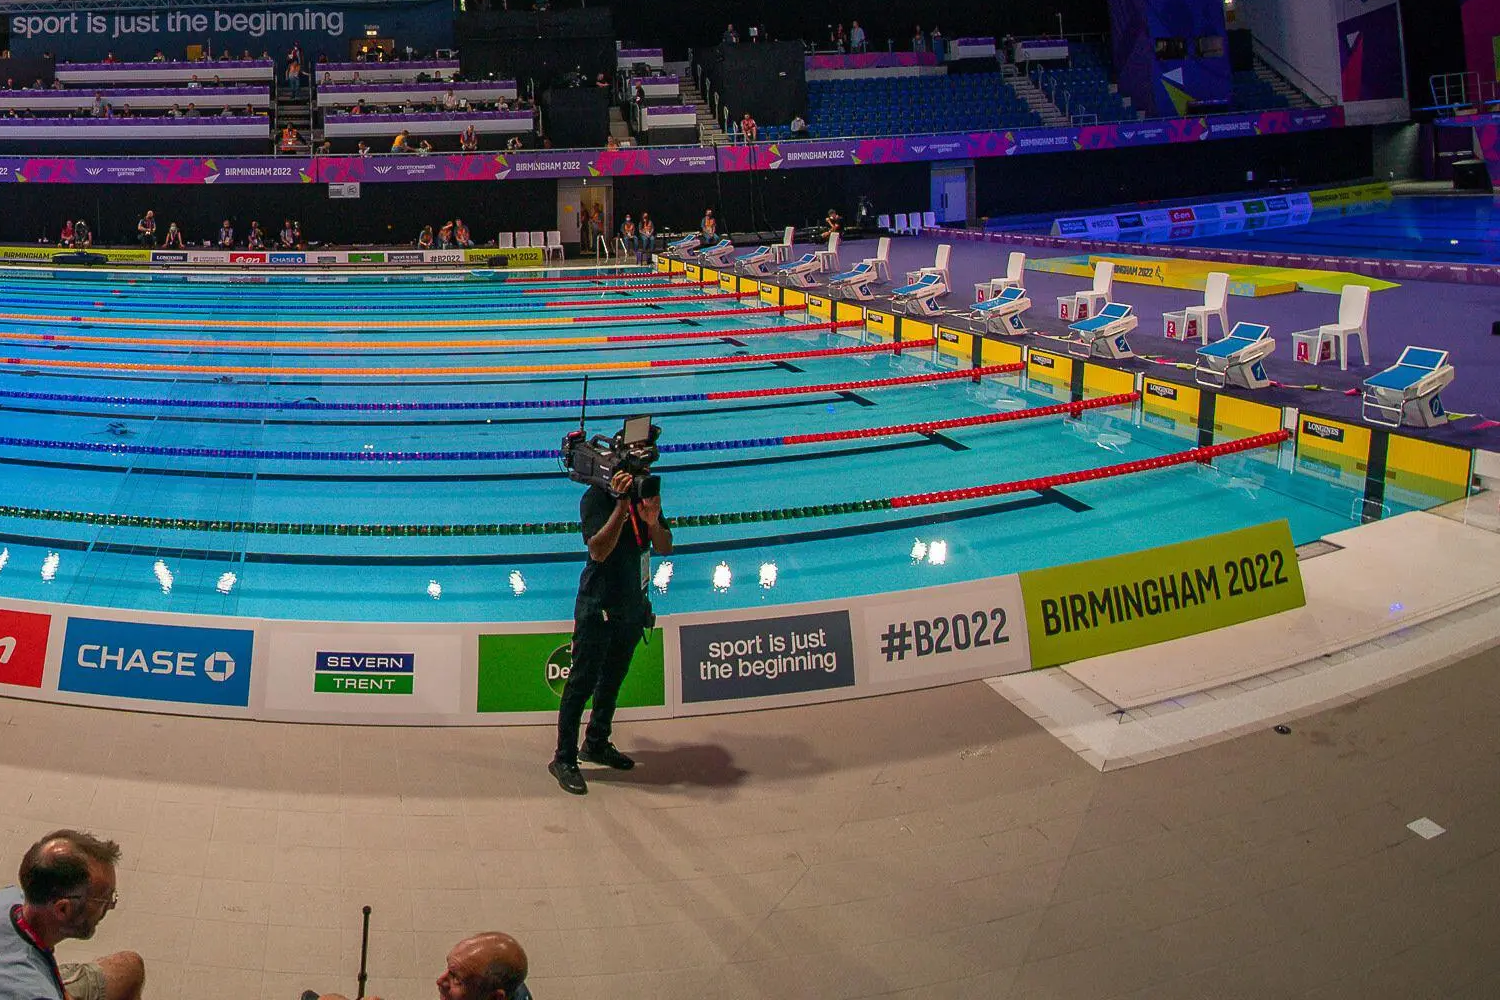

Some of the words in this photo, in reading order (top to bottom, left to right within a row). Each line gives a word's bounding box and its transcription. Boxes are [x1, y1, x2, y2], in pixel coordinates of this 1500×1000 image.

[12, 14, 78, 39] sport
[87, 11, 107, 33] is
[112, 12, 160, 39] just
[167, 10, 208, 33] the
[214, 8, 344, 38] beginning
[787, 151, 828, 161] BIRMINGHAM
[828, 150, 845, 159] 2022
[225, 166, 272, 176] BIRMINGHAM
[273, 167, 292, 176] 2022
[516, 162, 561, 172] BIRMINGHAM
[562, 161, 581, 170] 2022
[520, 253, 539, 261] 2022
[1014, 318, 1018, 326] 3
[1169, 324, 1174, 332] 2
[1120, 340, 1125, 349] 2
[1300, 344, 1304, 355] 1
[1257, 366, 1261, 376] 1
[1433, 401, 1440, 414] 0
[1308, 422, 1340, 436] LONGINES
[1040, 566, 1221, 636] BIRMINGHAM
[1224, 550, 1288, 596] 2022
[880, 608, 1010, 662] #B2022
[708, 635, 762, 660] sport
[769, 633, 786, 651] is
[787, 628, 827, 651] just
[77, 644, 198, 677] CHASE
[326, 656, 403, 669] SEVERN
[700, 660, 734, 681] the
[738, 649, 837, 681] beginning
[332, 678, 396, 690] TRENT
